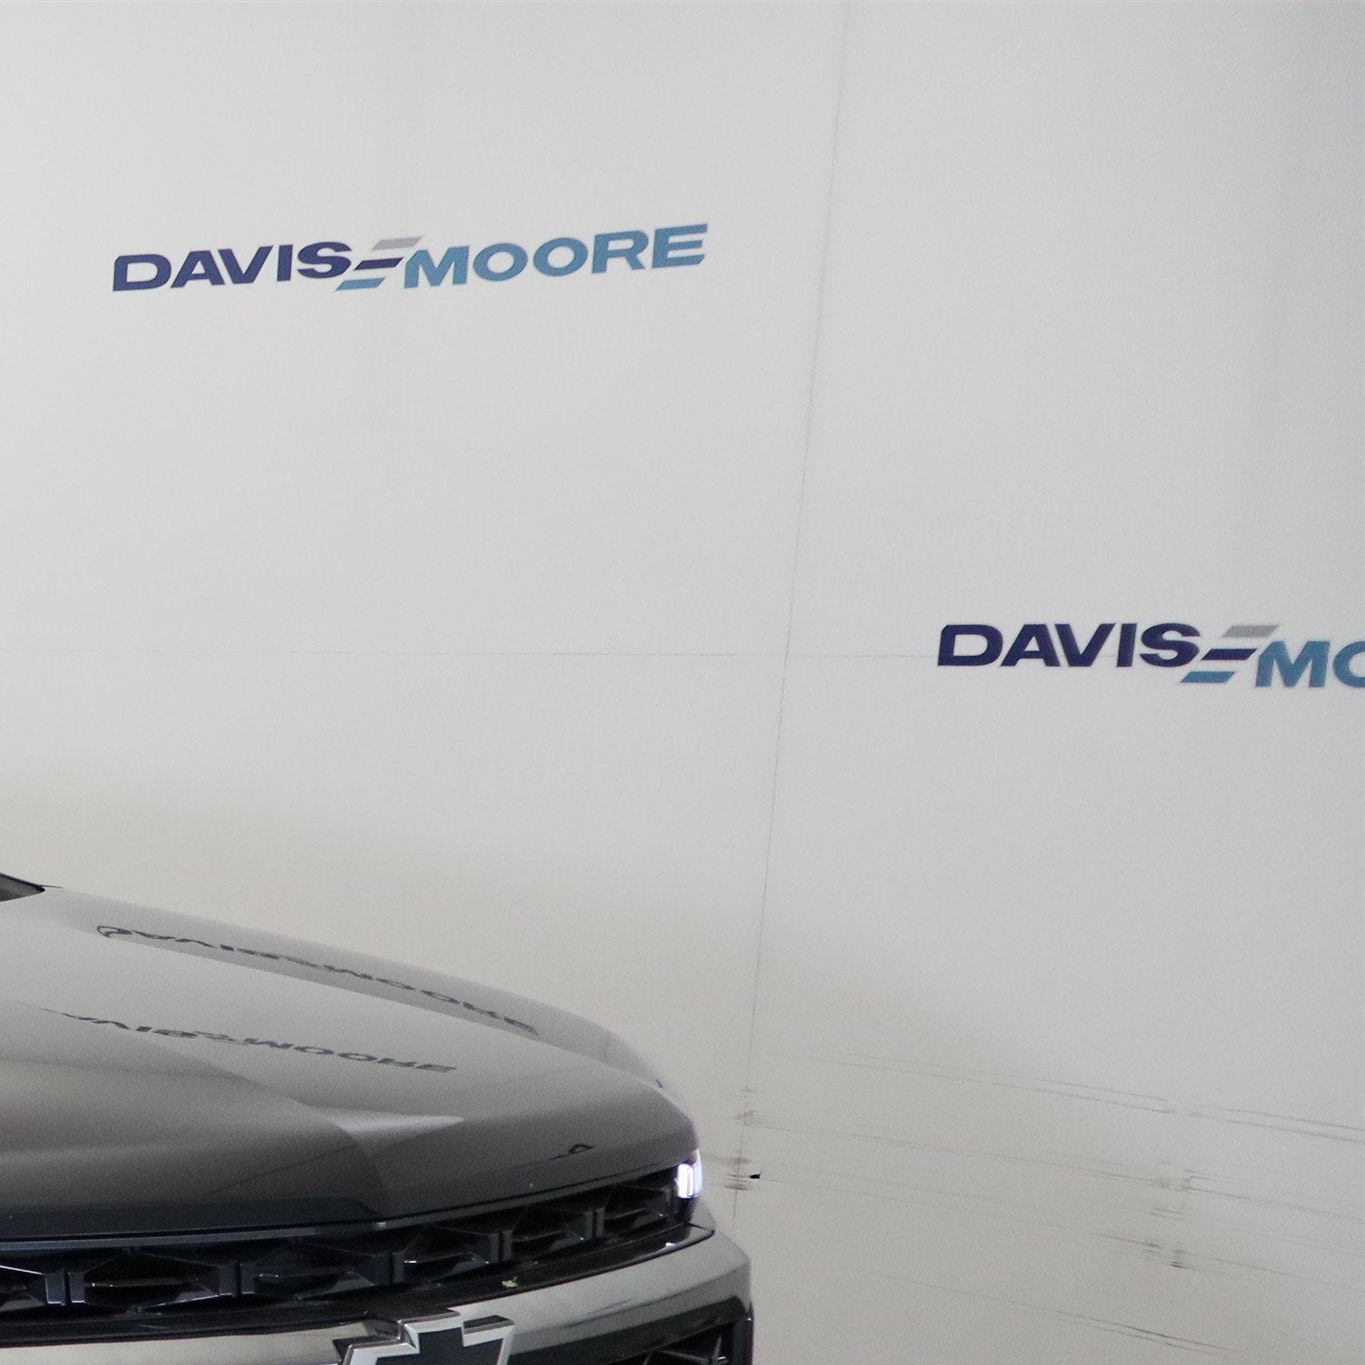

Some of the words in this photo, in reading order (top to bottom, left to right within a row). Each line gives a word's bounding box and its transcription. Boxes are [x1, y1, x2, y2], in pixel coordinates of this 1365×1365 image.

[111, 240, 352, 292] DAVIS
[401, 222, 709, 290] MOORE
[936, 621, 1203, 669] DAVIS
